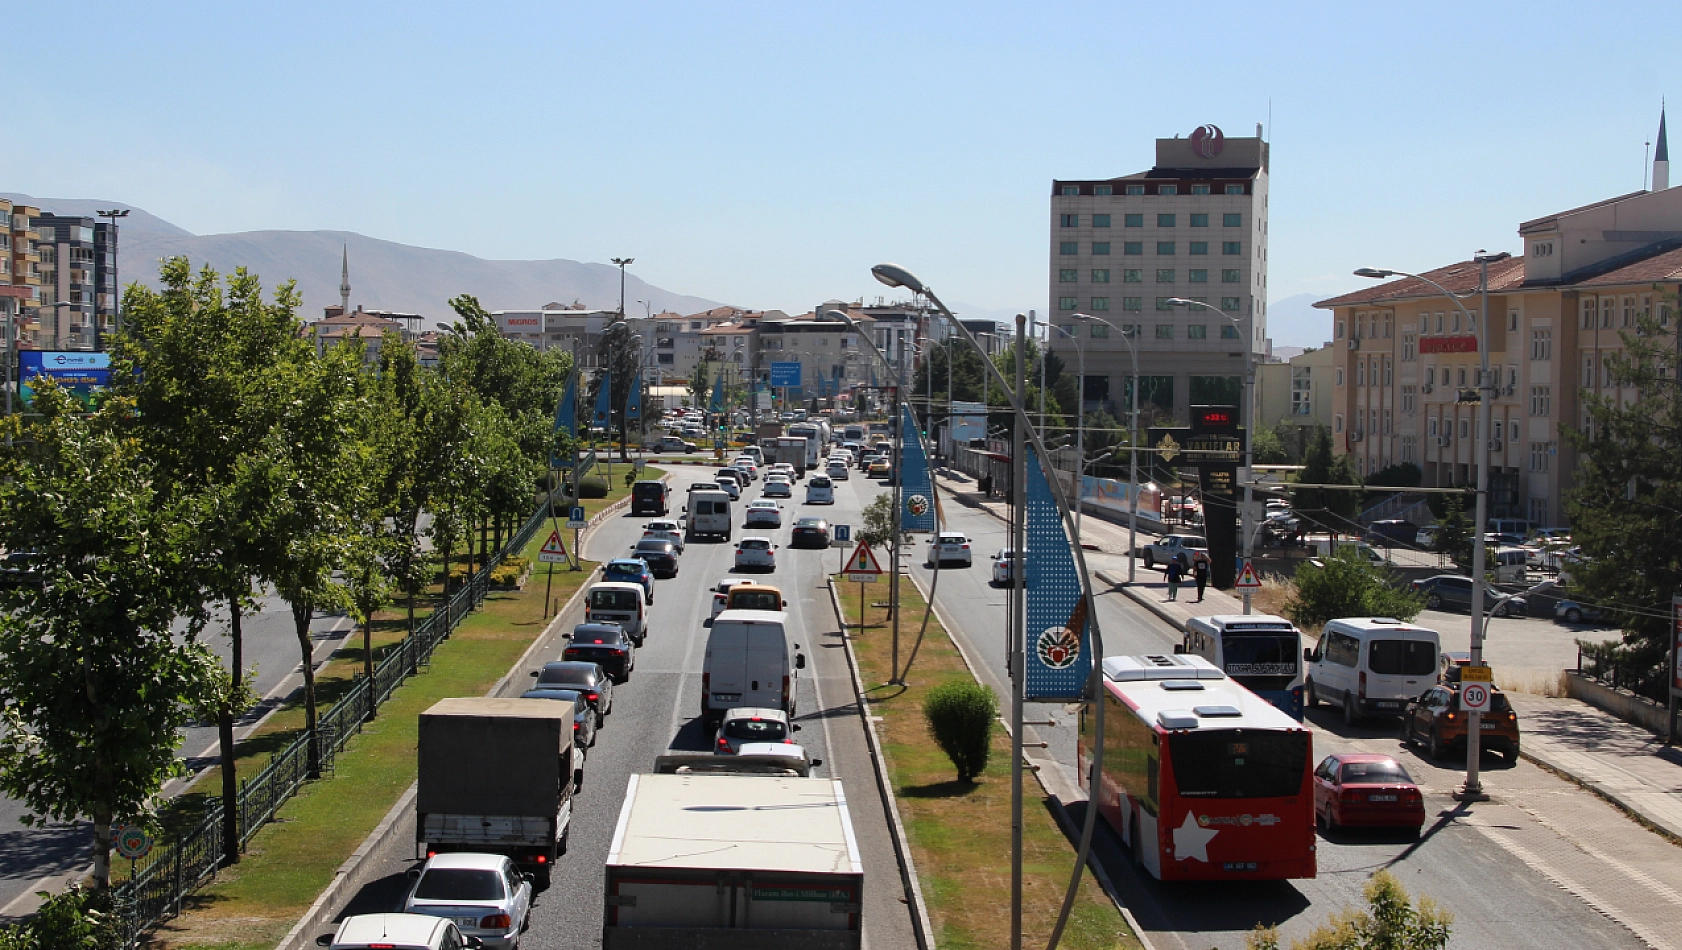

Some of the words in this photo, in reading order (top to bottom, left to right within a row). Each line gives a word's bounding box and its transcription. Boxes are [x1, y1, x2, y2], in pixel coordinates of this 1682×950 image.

[1187, 441, 1240, 451] VAKIFLAR
[1468, 690, 1483, 702] 30
[754, 889, 779, 897] Haram
[801, 889, 827, 898] Milhan
